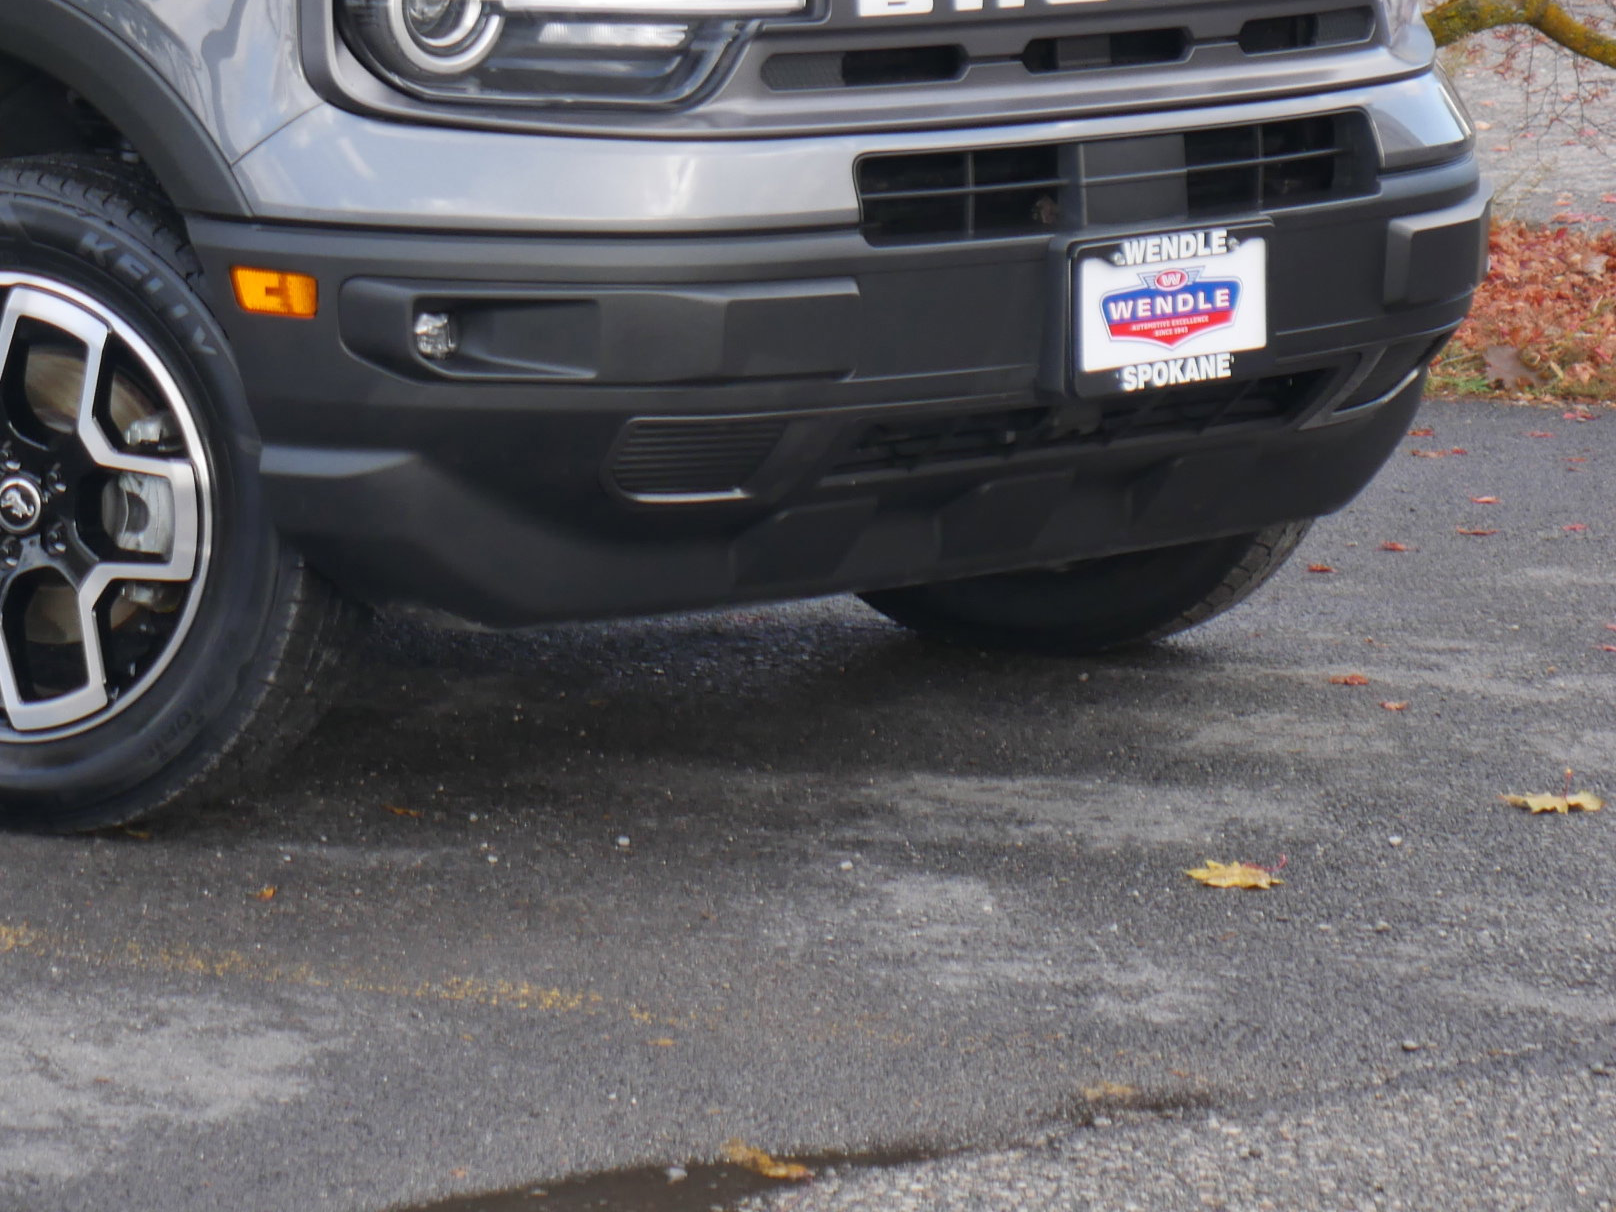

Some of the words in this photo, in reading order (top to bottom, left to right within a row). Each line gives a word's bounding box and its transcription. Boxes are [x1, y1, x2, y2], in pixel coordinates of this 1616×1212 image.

[1123, 228, 1228, 265] WENDLE
[76, 231, 218, 357] KELLY
[1161, 273, 1182, 287] W
[1108, 287, 1230, 320] WENDLE
[1122, 352, 1232, 392] SPOKANE
